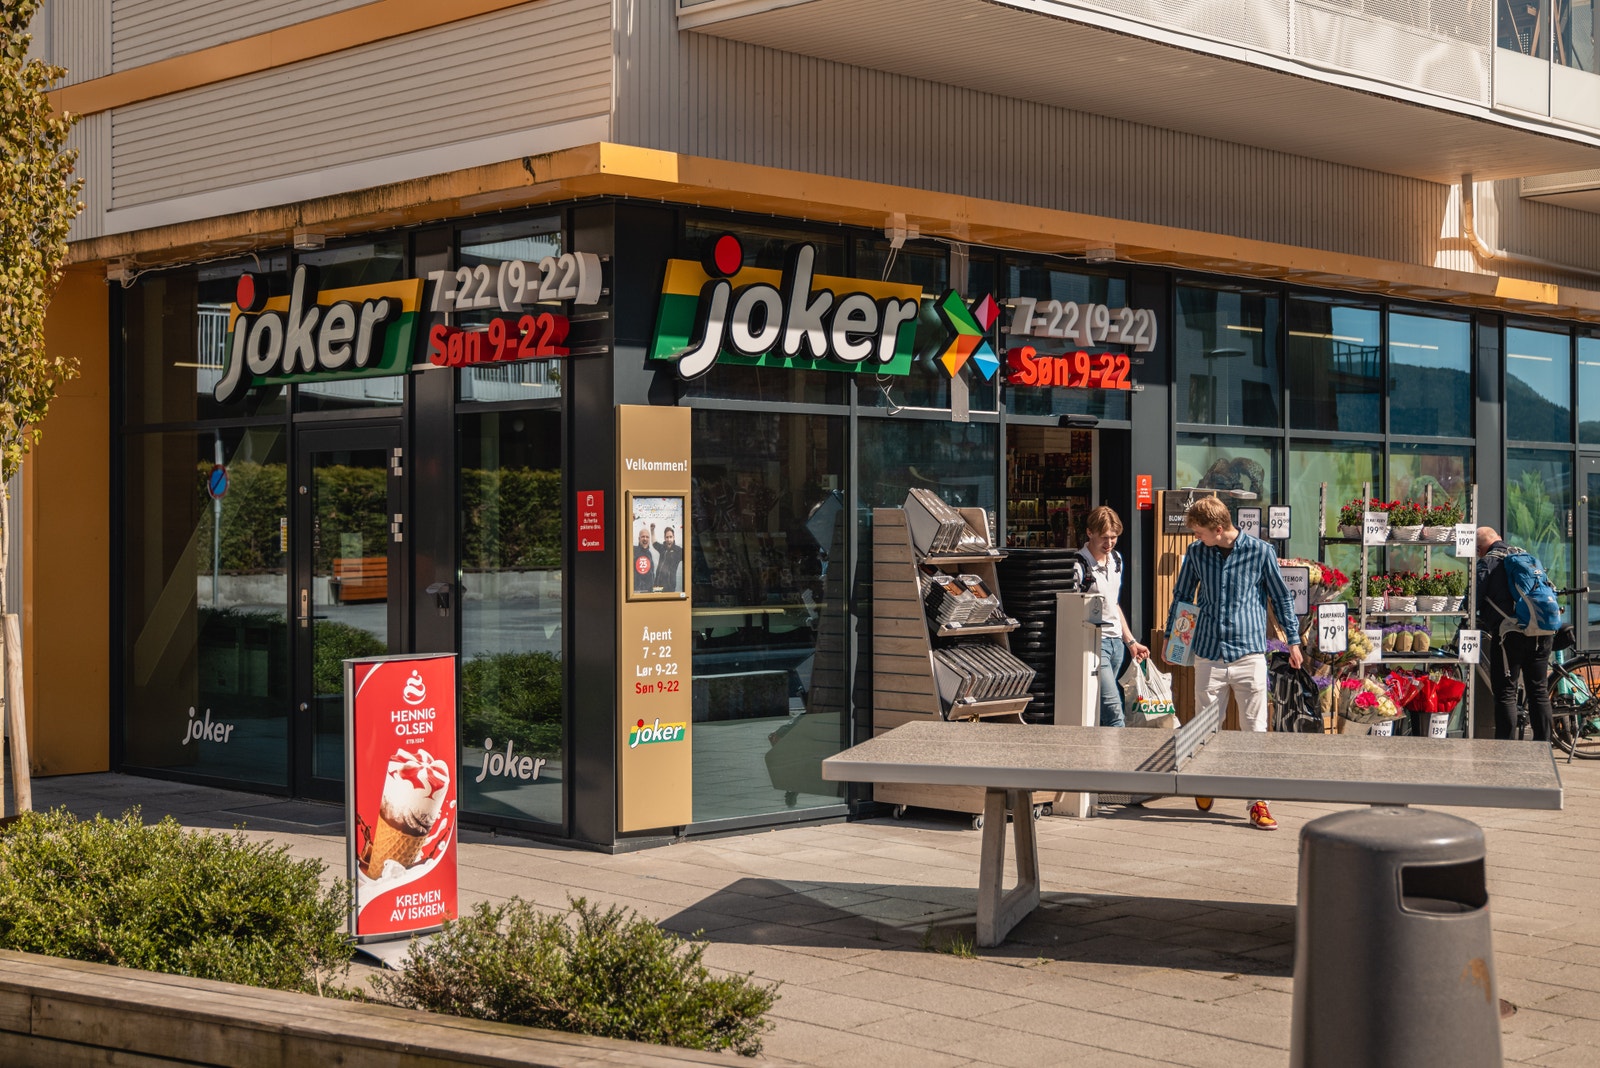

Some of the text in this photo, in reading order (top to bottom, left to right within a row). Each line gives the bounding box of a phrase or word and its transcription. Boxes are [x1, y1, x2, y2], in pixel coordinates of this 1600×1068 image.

[428, 251, 586, 313] 7-22 (9-22)
[677, 234, 918, 380] joker
[214, 264, 389, 403] joker
[1021, 296, 1158, 352] 7-22 (9-22)
[429, 312, 555, 367] Søn 9-22
[1020, 345, 1131, 389] Søn 9-22
[625, 458, 688, 472] Velkommen!
[642, 626, 672, 643] Åpent
[643, 647, 649, 659] 7
[659, 645, 672, 658] 22
[636, 663, 678, 677] Lør 9-22
[635, 680, 680, 694] Søn 9-22
[182, 706, 234, 745] joker
[391, 707, 436, 722] HENNIG
[395, 721, 433, 736] OLSEN
[630, 718, 682, 749] joker
[475, 737, 546, 783] joker
[390, 901, 445, 922] AV ISKREM
[396, 889, 441, 908] KREMEN
